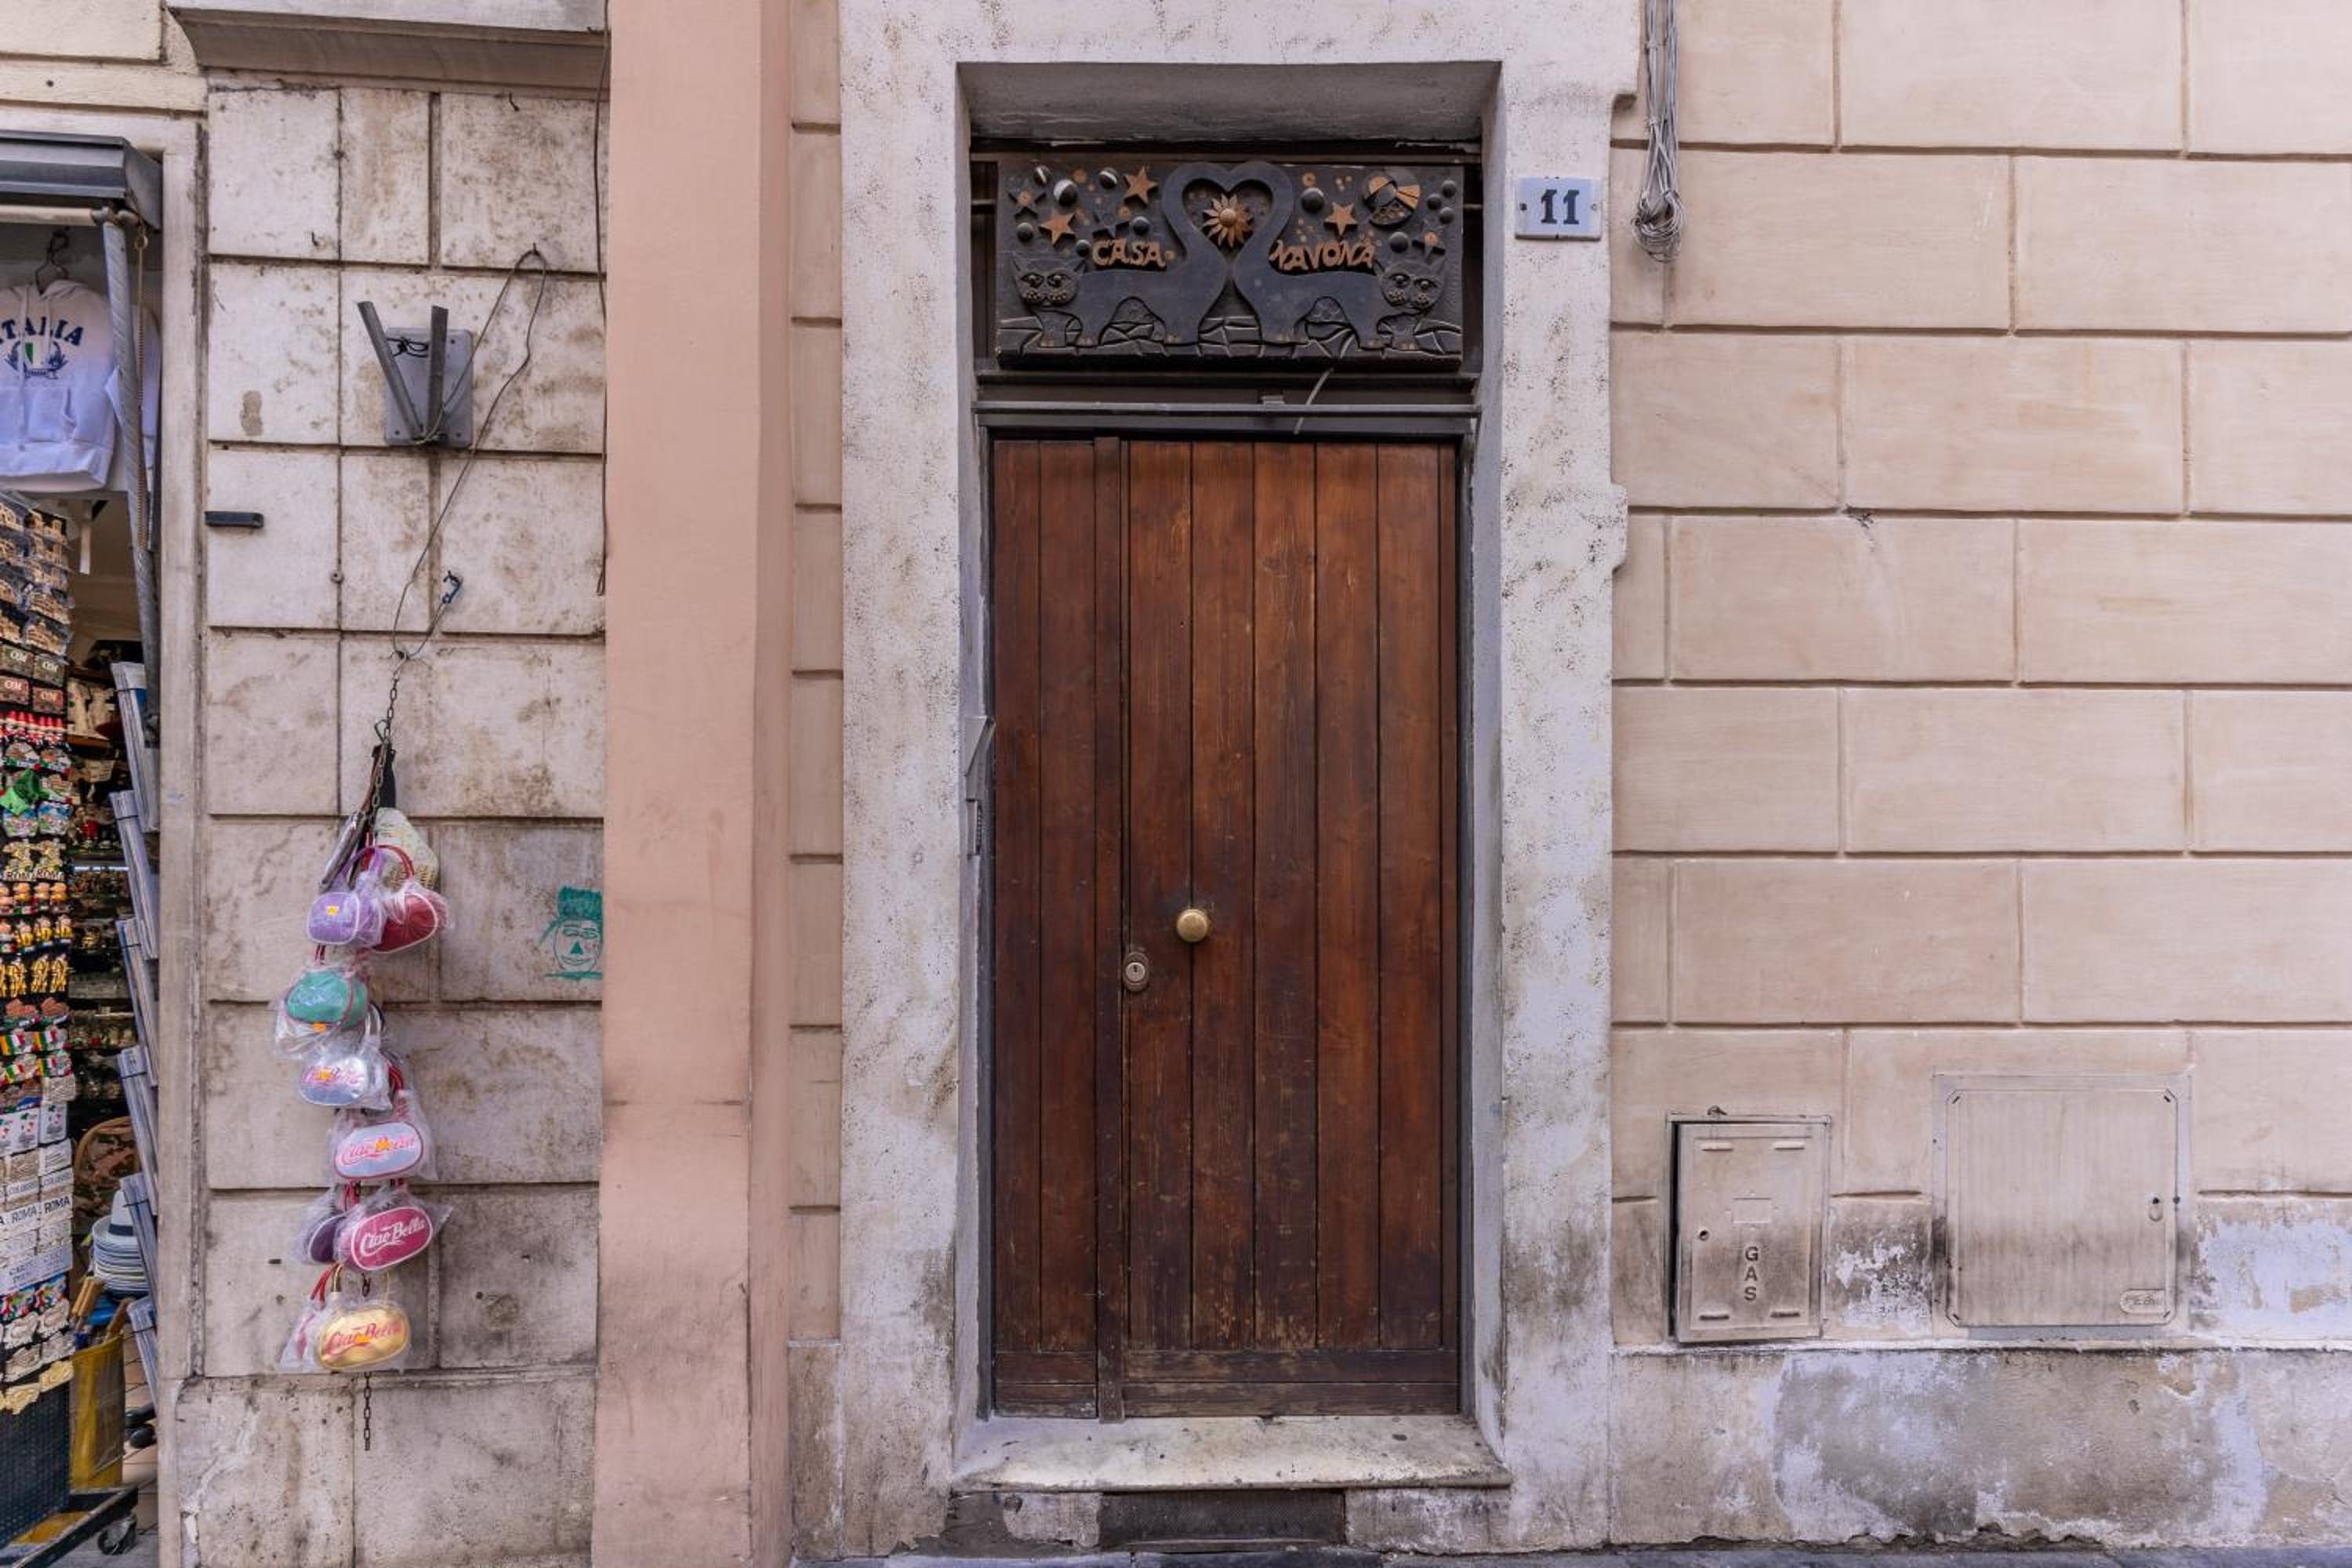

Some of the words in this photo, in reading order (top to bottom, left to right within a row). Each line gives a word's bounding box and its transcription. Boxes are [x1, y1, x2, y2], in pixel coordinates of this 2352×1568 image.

[1540, 189, 1580, 225] 11
[1092, 238, 1166, 267] CASA
[0, 317, 83, 346] TALIA
[360, 1231, 393, 1257] Ciao
[387, 1217, 425, 1242] Bella
[1744, 1246, 1759, 1301] GAS
